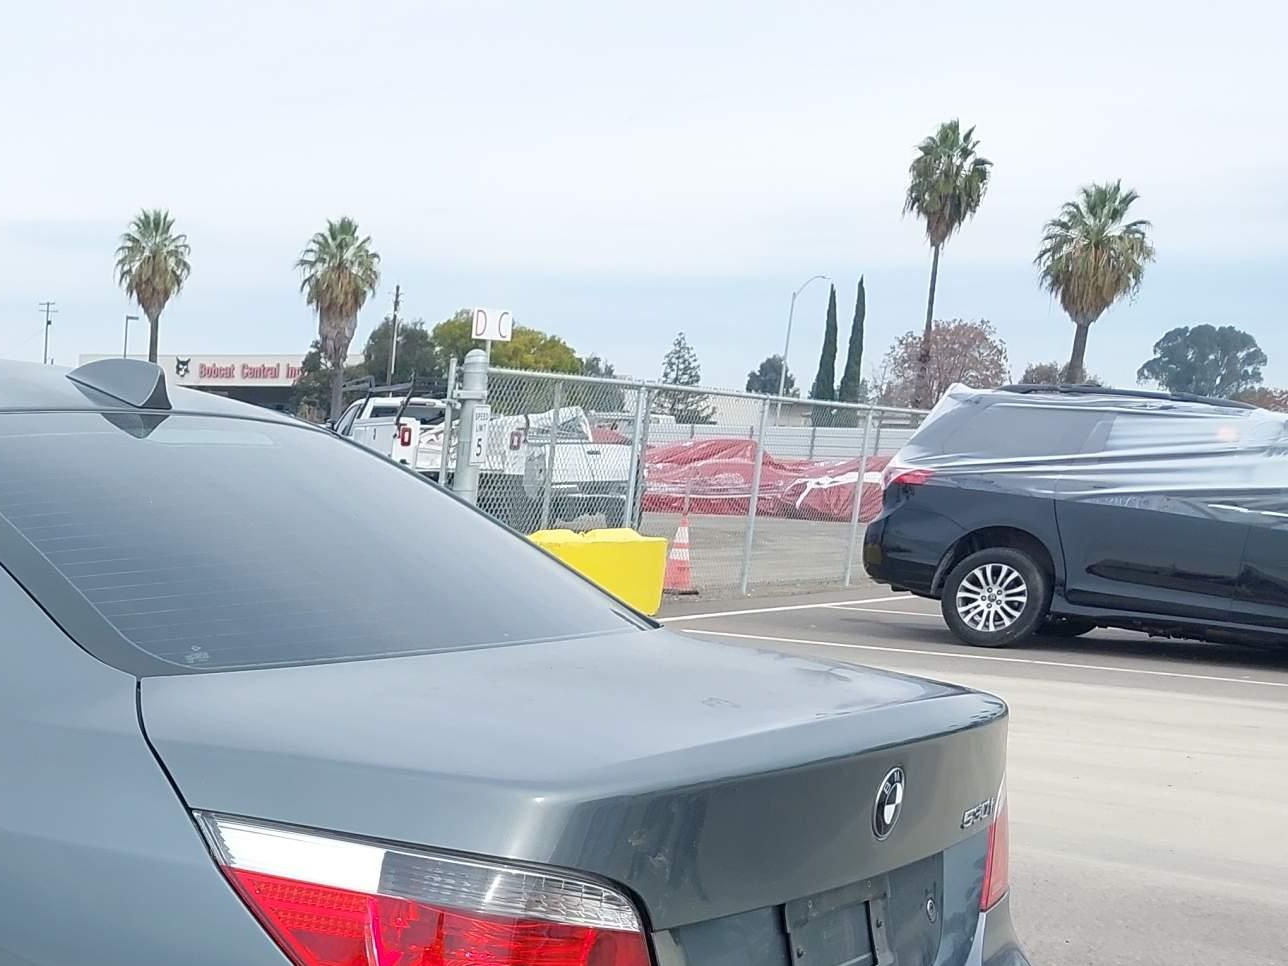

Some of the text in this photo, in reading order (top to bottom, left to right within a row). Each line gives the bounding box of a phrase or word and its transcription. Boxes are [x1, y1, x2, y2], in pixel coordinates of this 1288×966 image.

[199, 362, 235, 379] Bobcat
[241, 362, 280, 379] Central
[475, 437, 482, 457] 5
